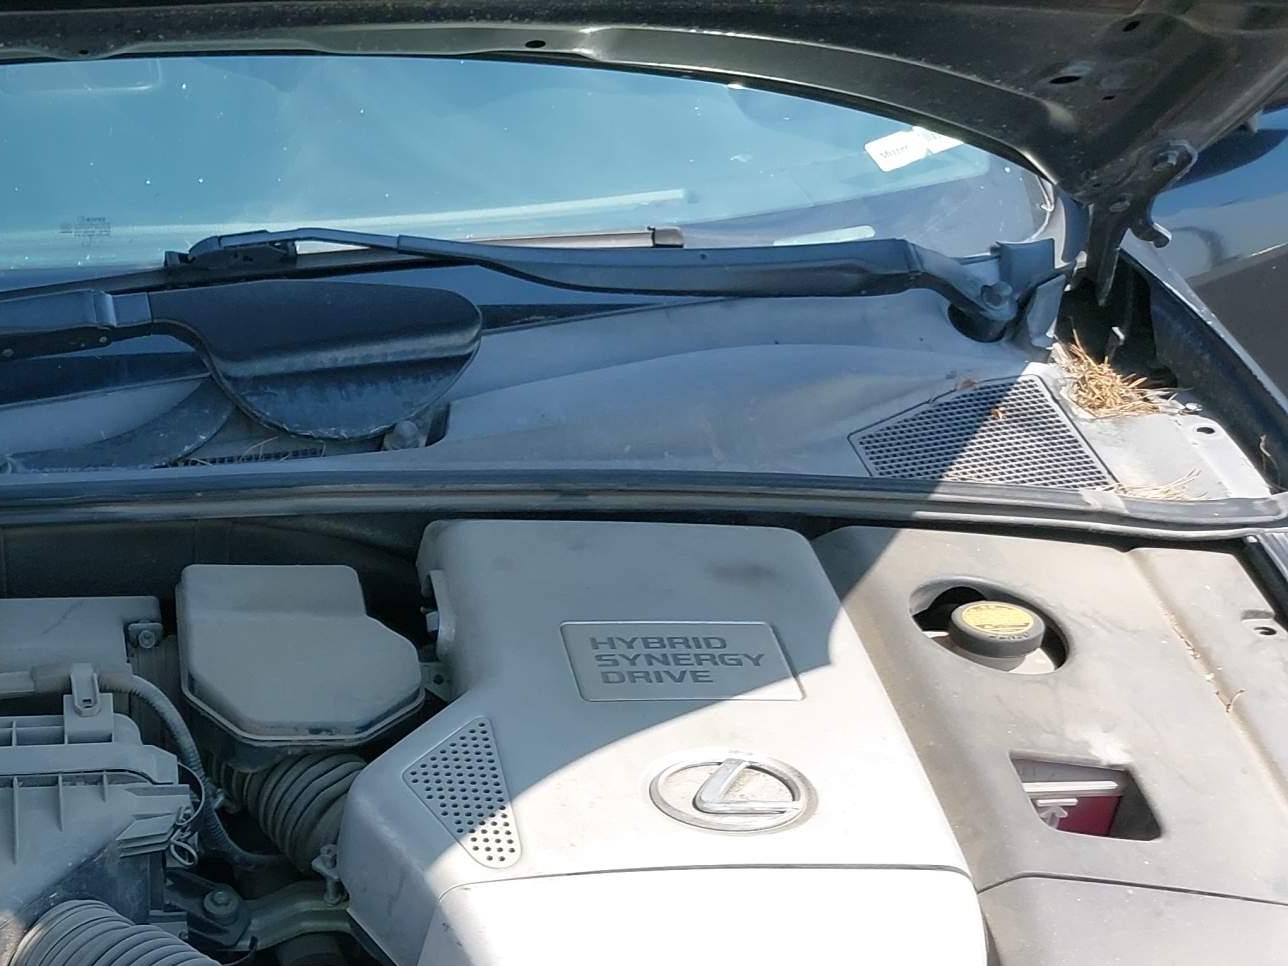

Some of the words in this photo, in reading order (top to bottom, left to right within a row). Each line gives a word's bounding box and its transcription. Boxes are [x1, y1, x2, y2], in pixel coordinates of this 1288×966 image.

[589, 636, 727, 650] HYBRID
[594, 653, 765, 667] SYNERGY
[600, 670, 714, 684] DRIVE
